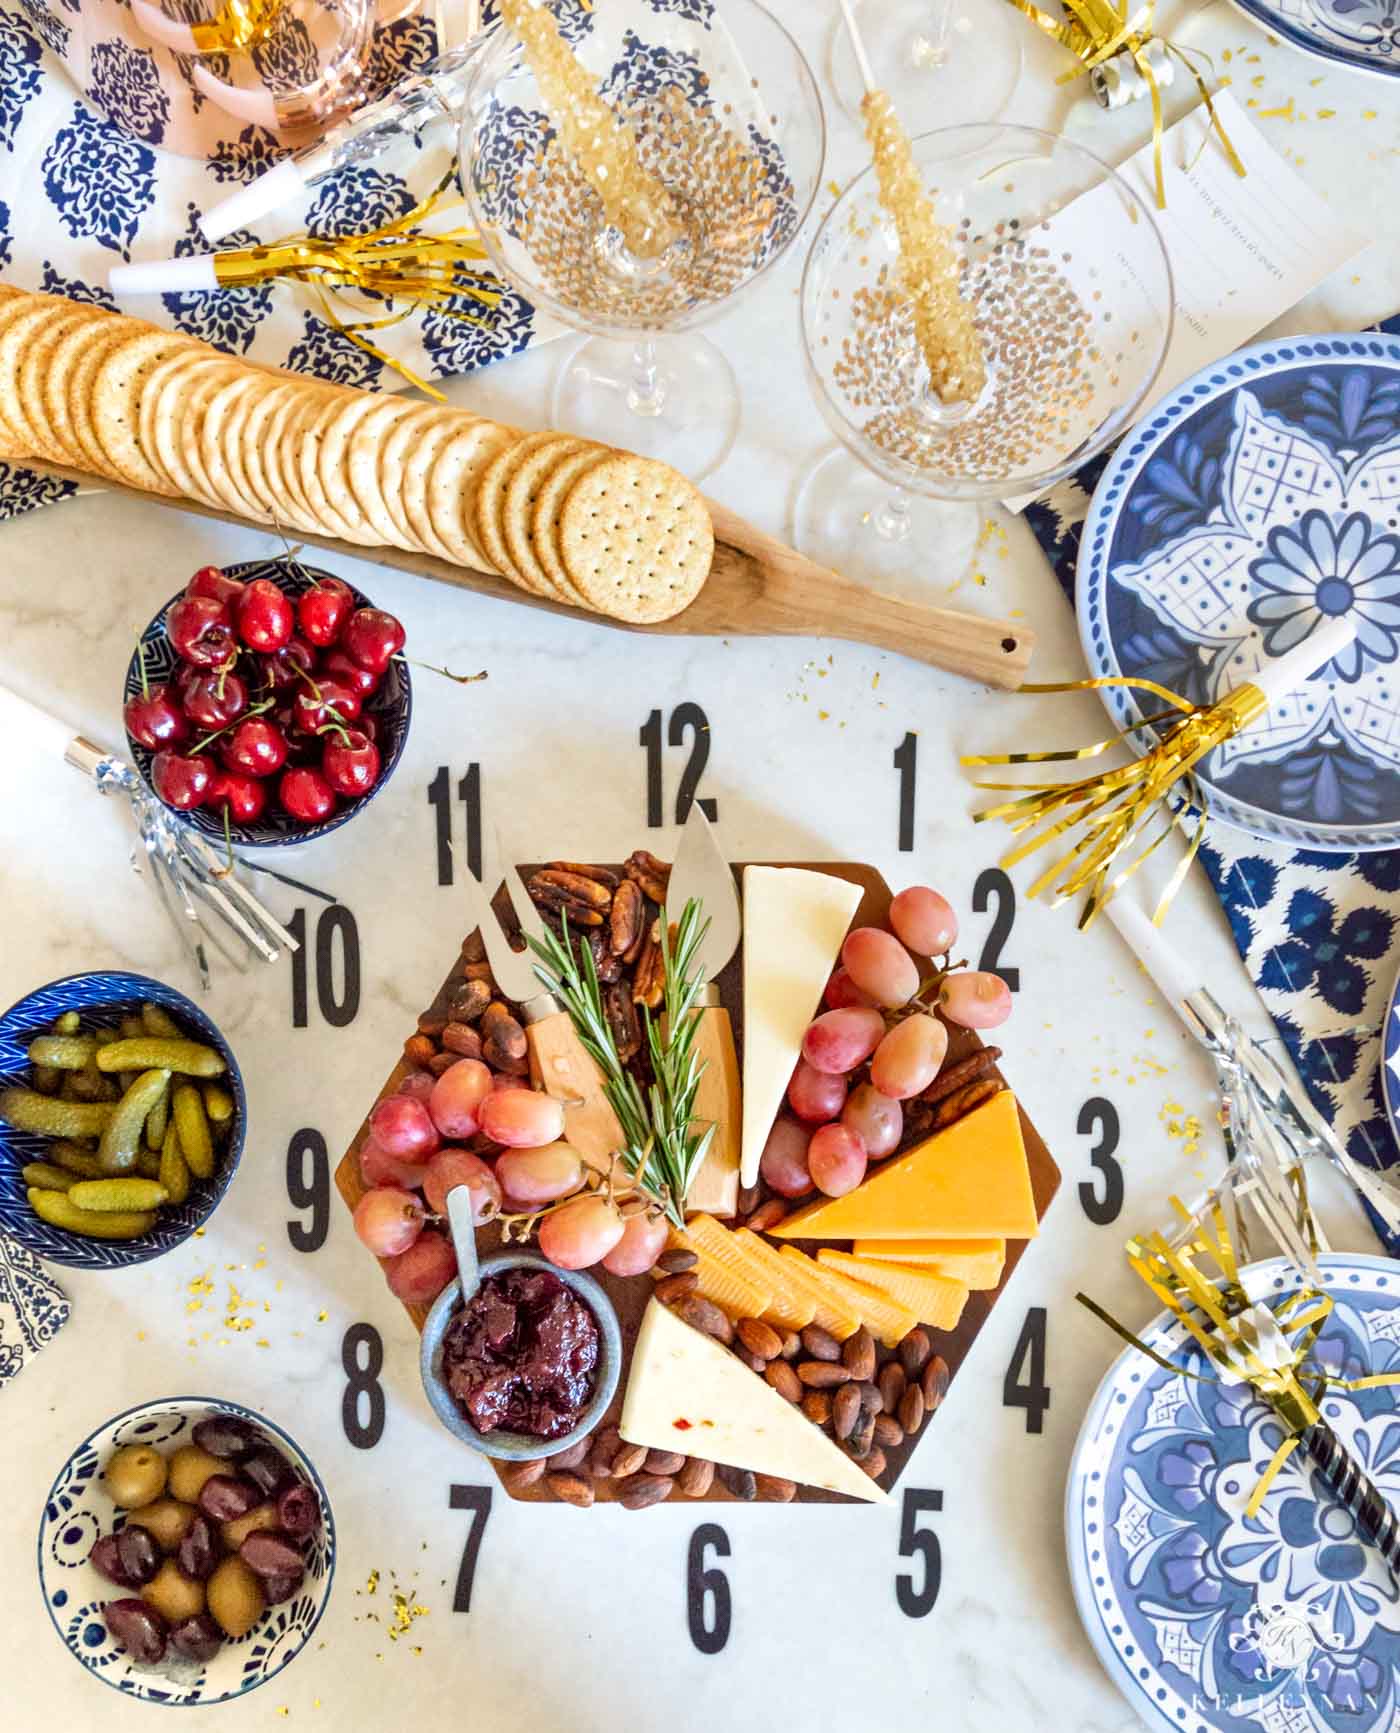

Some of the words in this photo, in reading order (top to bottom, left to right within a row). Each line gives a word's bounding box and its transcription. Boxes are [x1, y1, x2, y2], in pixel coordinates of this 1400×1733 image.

[427, 762, 482, 886] 11
[639, 702, 718, 828] 12
[894, 732, 917, 852] 1
[282, 904, 361, 1028] 10
[972, 868, 1020, 993] 2
[286, 1127, 330, 1253] 9
[1077, 1097, 1124, 1226] 3
[341, 1322, 386, 1450] 8
[1002, 1307, 1051, 1434] 4
[449, 1484, 492, 1613] 7
[687, 1523, 731, 1655] 6
[896, 1487, 943, 1618] 5
